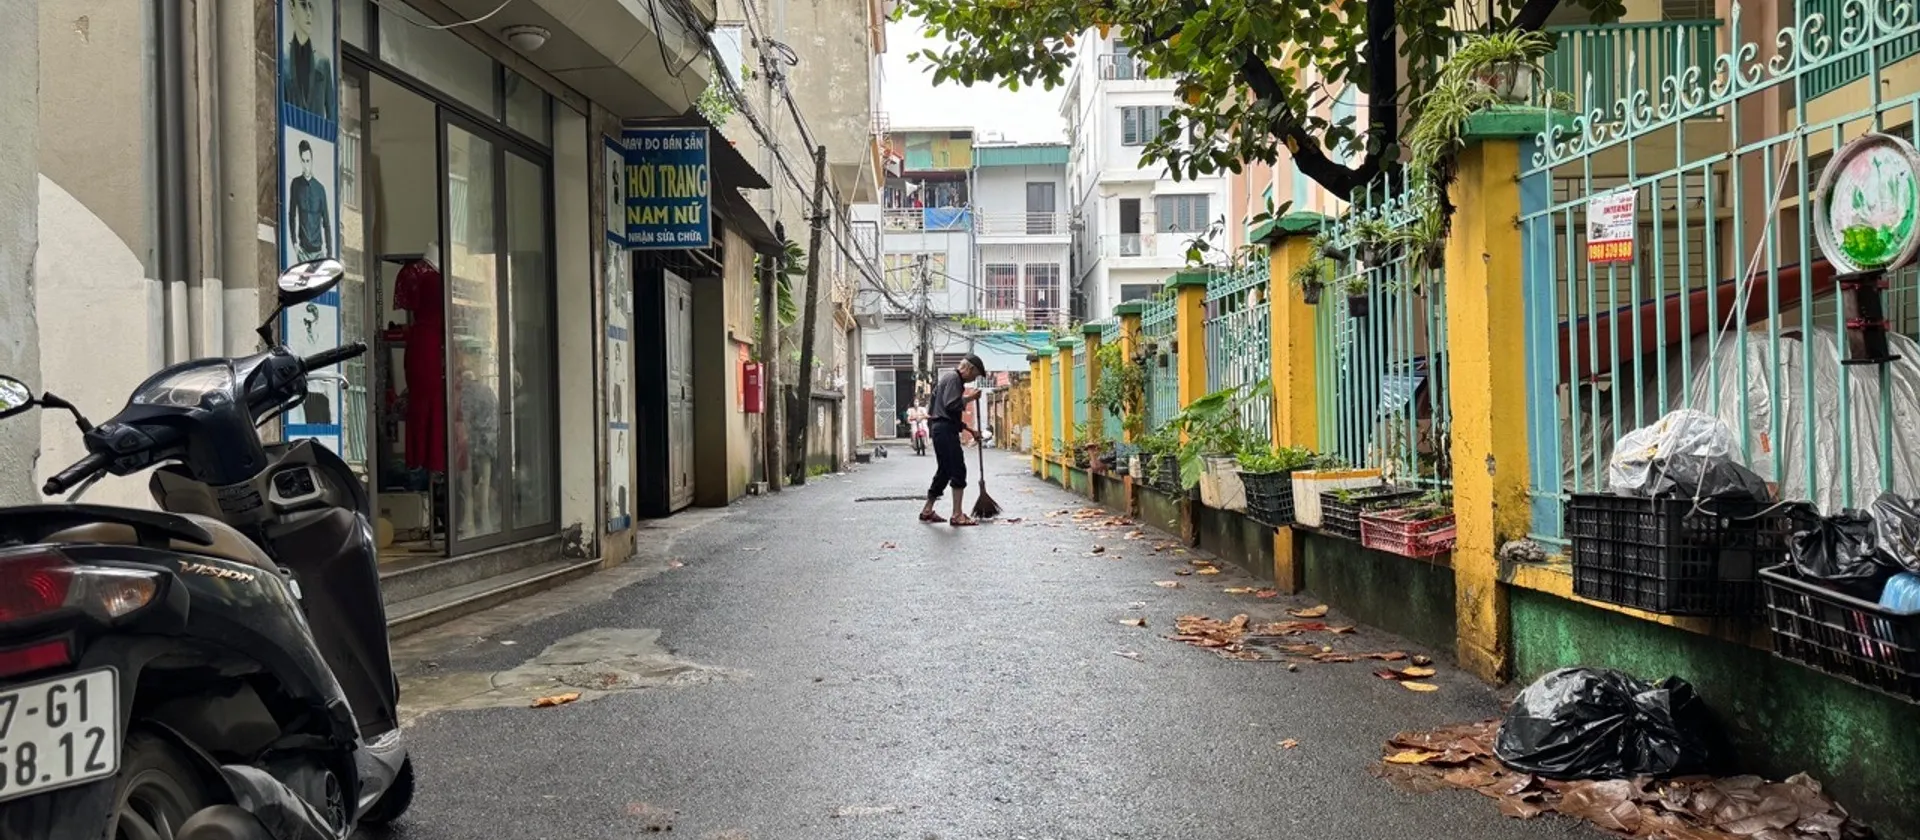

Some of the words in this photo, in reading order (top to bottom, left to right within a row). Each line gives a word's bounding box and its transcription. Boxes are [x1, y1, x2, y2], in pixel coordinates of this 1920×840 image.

[645, 137, 660, 150] ĐO
[663, 134, 682, 150] BÁN
[659, 163, 707, 198] TRANG
[627, 205, 669, 225] NAM
[674, 201, 703, 224] NỮ
[1603, 202, 1633, 215] INTERNET
[628, 230, 654, 244] NHẬN
[656, 228, 675, 243] SỬA
[677, 229, 702, 243] CHỮA
[177, 560, 255, 584] VISION
